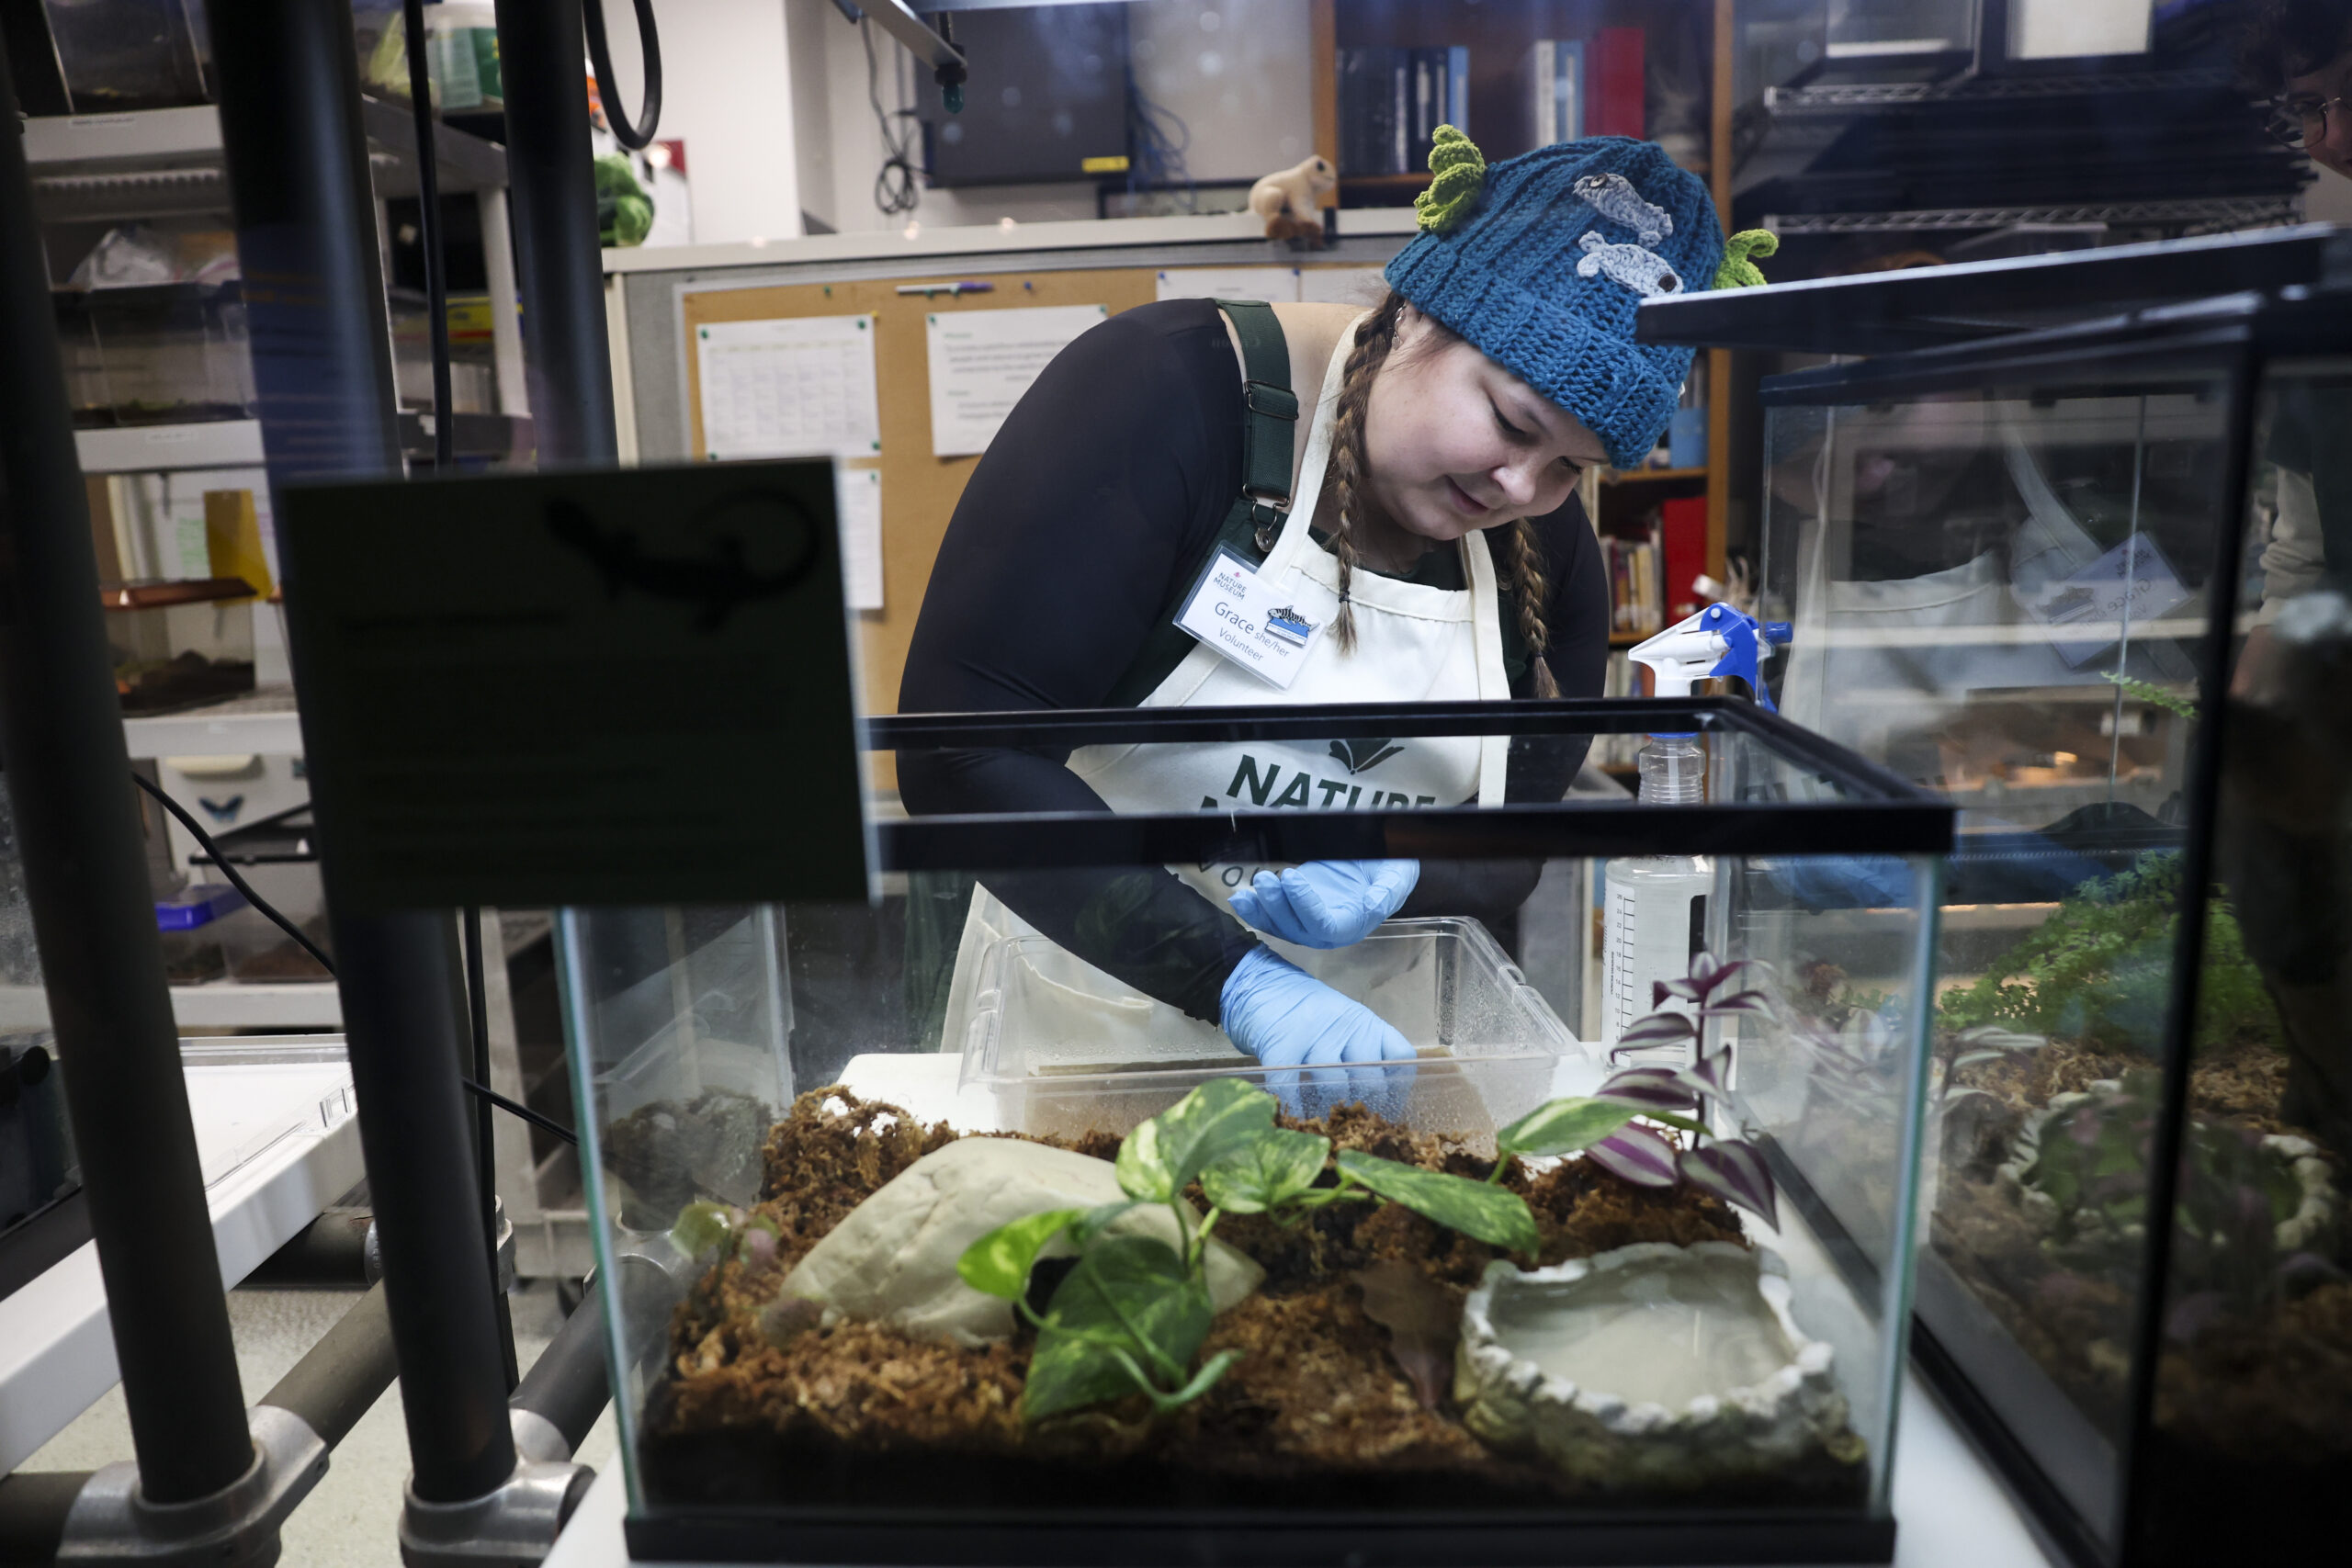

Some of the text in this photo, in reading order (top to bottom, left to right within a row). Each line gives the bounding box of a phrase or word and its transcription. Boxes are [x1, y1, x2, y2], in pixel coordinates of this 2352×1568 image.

[1213, 577, 1245, 600] MUSEUM
[1218, 571, 1248, 593] NATURE
[1215, 602, 1255, 635] Grace
[1254, 631, 1290, 658] she/her
[1219, 626, 1264, 661] Volunteer
